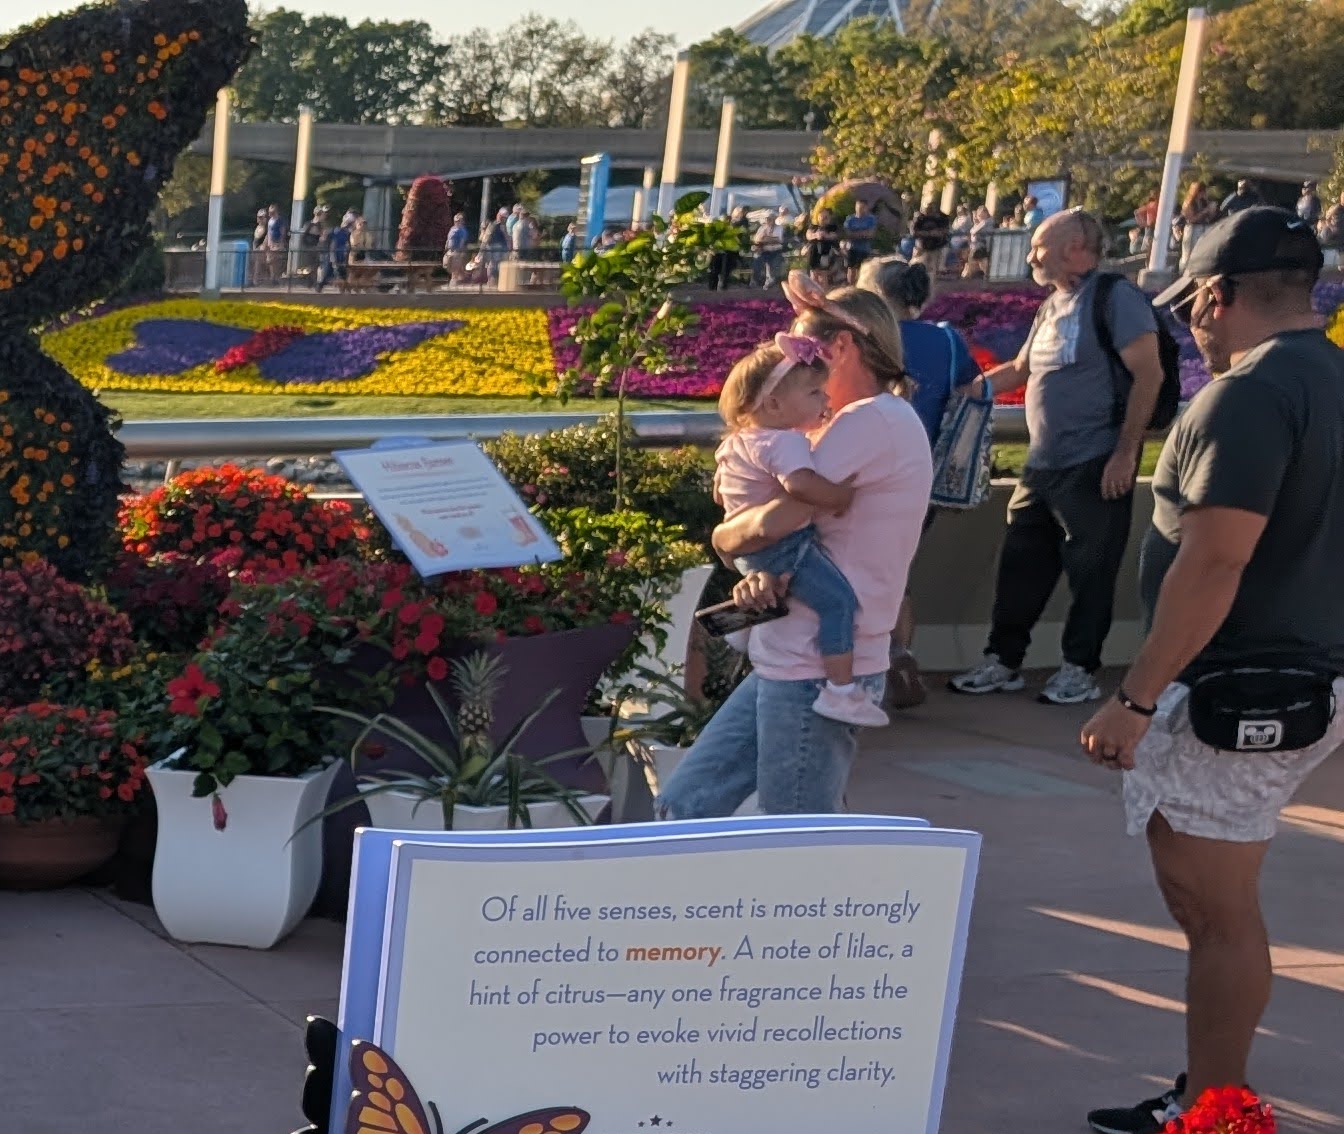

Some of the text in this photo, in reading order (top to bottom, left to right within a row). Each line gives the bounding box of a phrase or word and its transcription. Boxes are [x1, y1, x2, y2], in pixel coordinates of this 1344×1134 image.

[481, 889, 921, 924] Of all five senses, scent is most strongly
[473, 932, 914, 968] connected to memory. A note of lilac, a
[469, 979, 511, 1006] hint
[517, 977, 542, 1005] of
[671, 988, 713, 1003] one
[719, 975, 823, 1009] fragrance
[828, 973, 866, 1000] has
[872, 973, 908, 1000] the
[532, 1015, 902, 1053] power to evoke vivid recollections
[657, 1055, 896, 1090] with staggering clarity.
